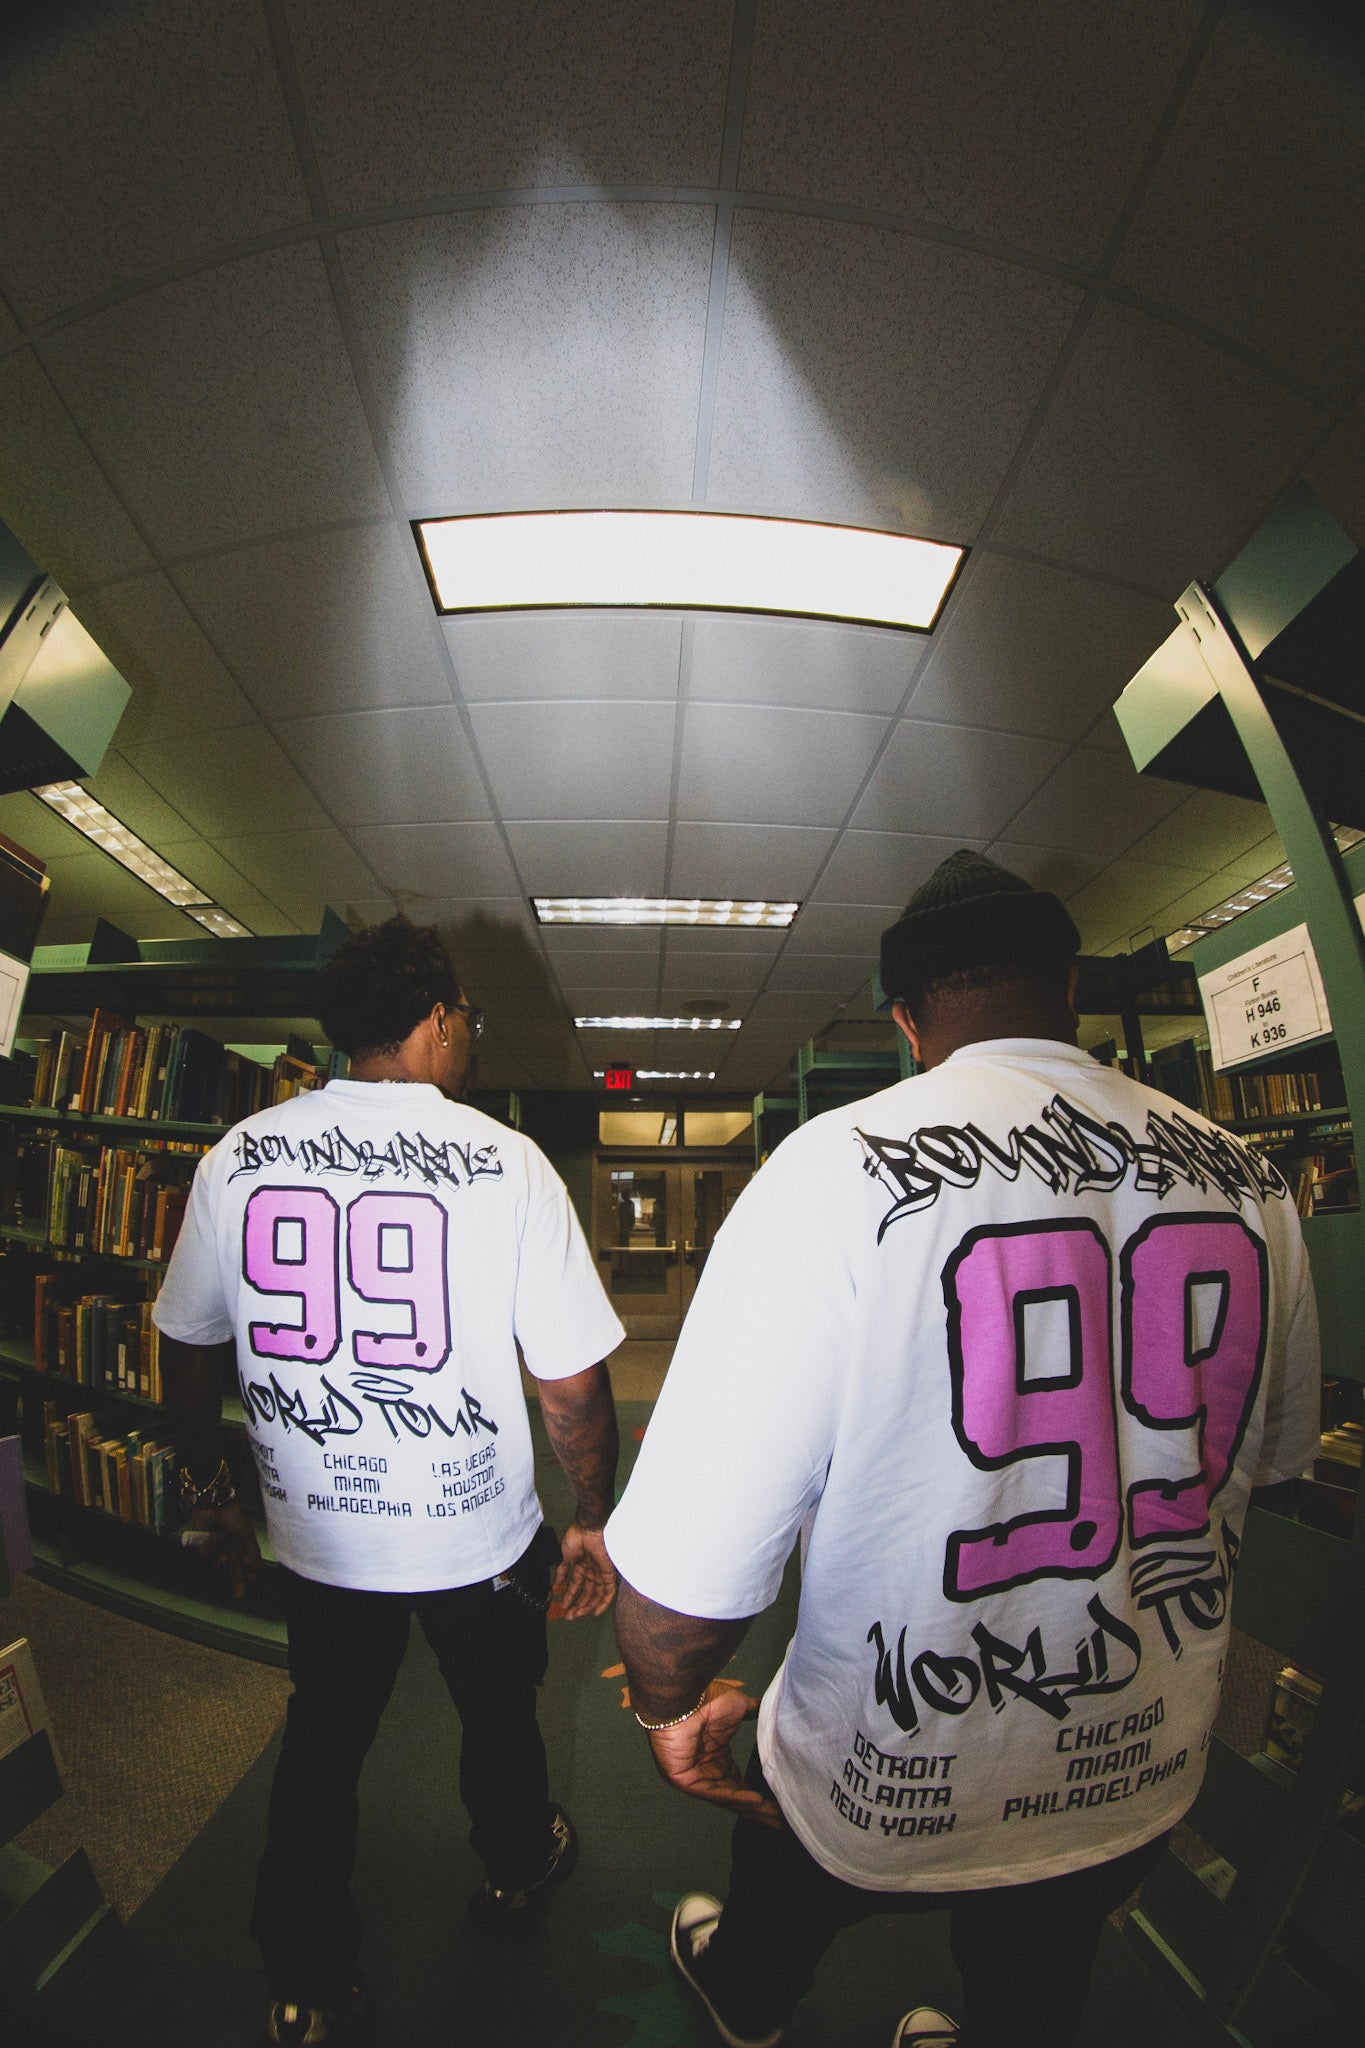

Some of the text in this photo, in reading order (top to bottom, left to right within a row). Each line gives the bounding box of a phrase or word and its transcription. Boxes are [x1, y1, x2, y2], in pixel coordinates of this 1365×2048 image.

[1252, 977, 1260, 993] F
[1246, 997, 1281, 1023] H 946
[1250, 1023, 1287, 1048] K 936
[606, 1070, 633, 1090] EXIT
[242, 1185, 453, 1374] 99
[362, 1387, 499, 1444] TOUR
[940, 1211, 1270, 1602] 99
[323, 1453, 387, 1474] CHICAGO
[432, 1442, 496, 1478] LAS VEGAS
[334, 1476, 380, 1494] MIAMI
[426, 1477, 505, 1518] LOS ANGELES
[442, 1465, 494, 1498] HOUSTON
[307, 1494, 412, 1517] PHILADELPHIA
[867, 1594, 1142, 1738] WORLD
[1056, 1696, 1165, 1752] CHICAGO
[854, 1730, 957, 1779] DETROIT
[1066, 1738, 1151, 1782] MIAMI
[843, 1758, 952, 1809] ATLANTA
[1003, 1748, 1187, 1821] PHILADELPHIA
[830, 1780, 957, 1836] NEW YORK
